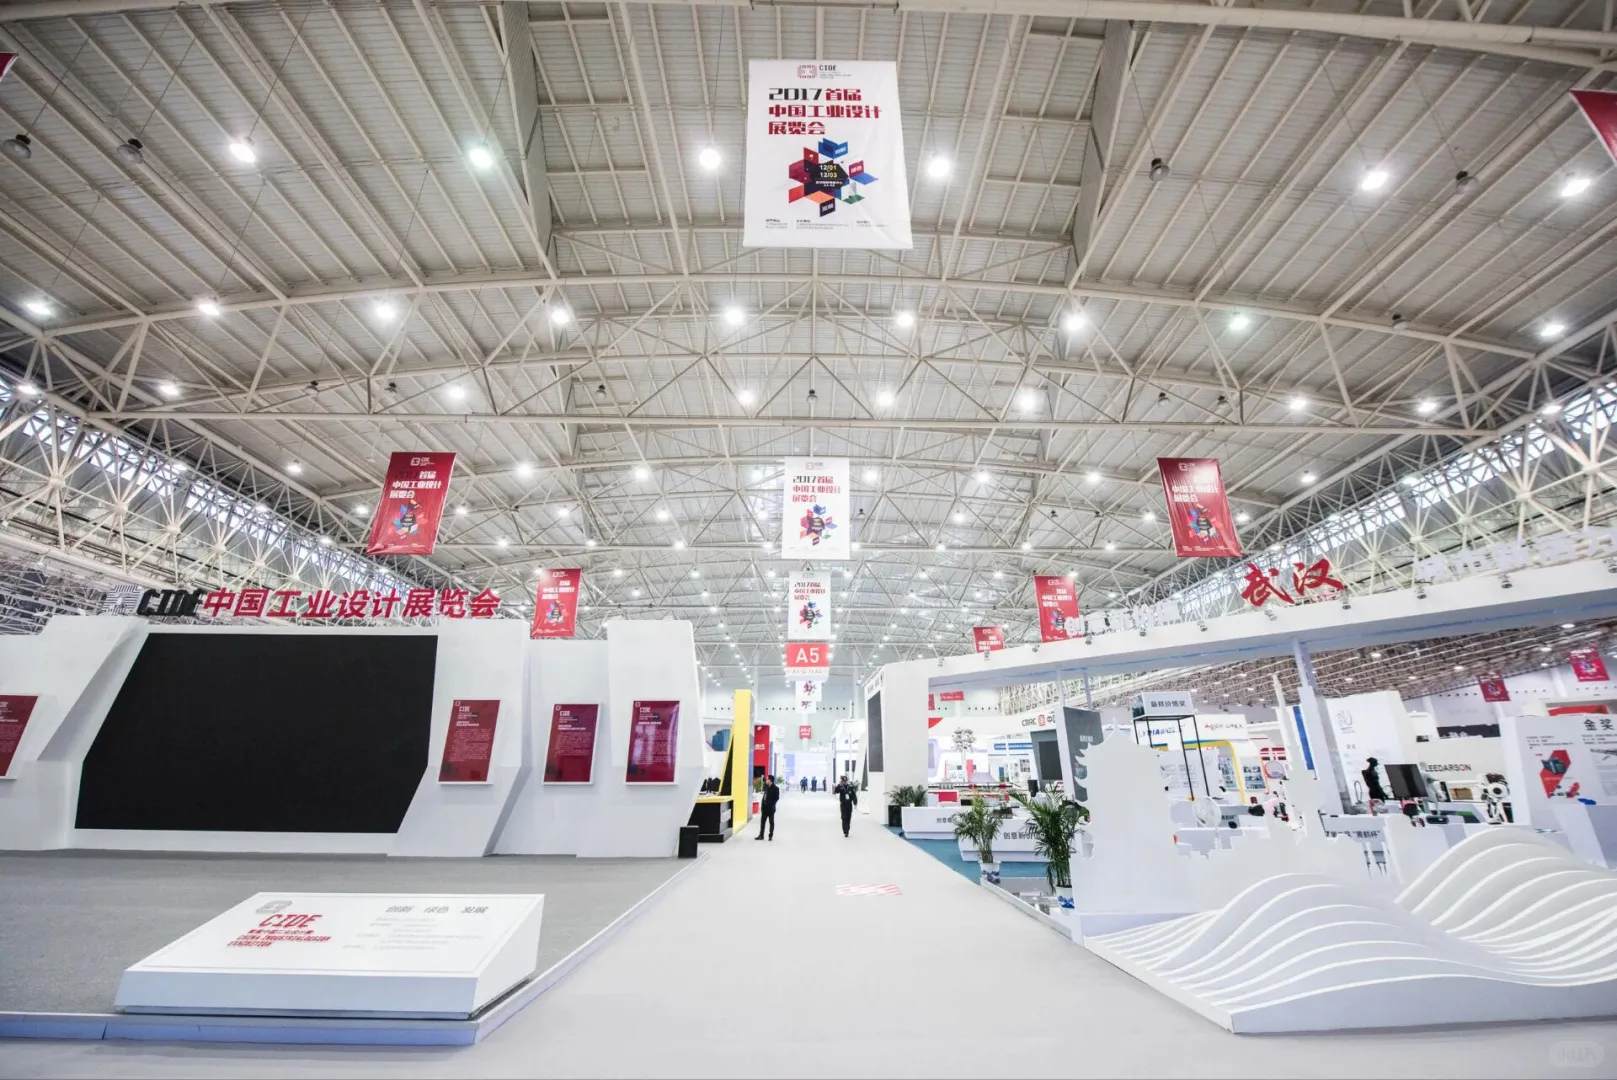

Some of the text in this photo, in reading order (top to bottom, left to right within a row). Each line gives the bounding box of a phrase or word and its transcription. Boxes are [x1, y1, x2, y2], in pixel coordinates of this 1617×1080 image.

[768, 88, 862, 101] 2017首届
[768, 104, 882, 119] 中国工业设计
[768, 121, 826, 135] 展览会
[1240, 557, 1346, 606] 武汉
[203, 586, 501, 619] 中国工业设计展览会
[795, 647, 820, 664] A5
[1583, 718, 1614, 731] 金奖
[1425, 763, 1472, 773] LEEDARSON
[258, 914, 323, 928] CIDE
